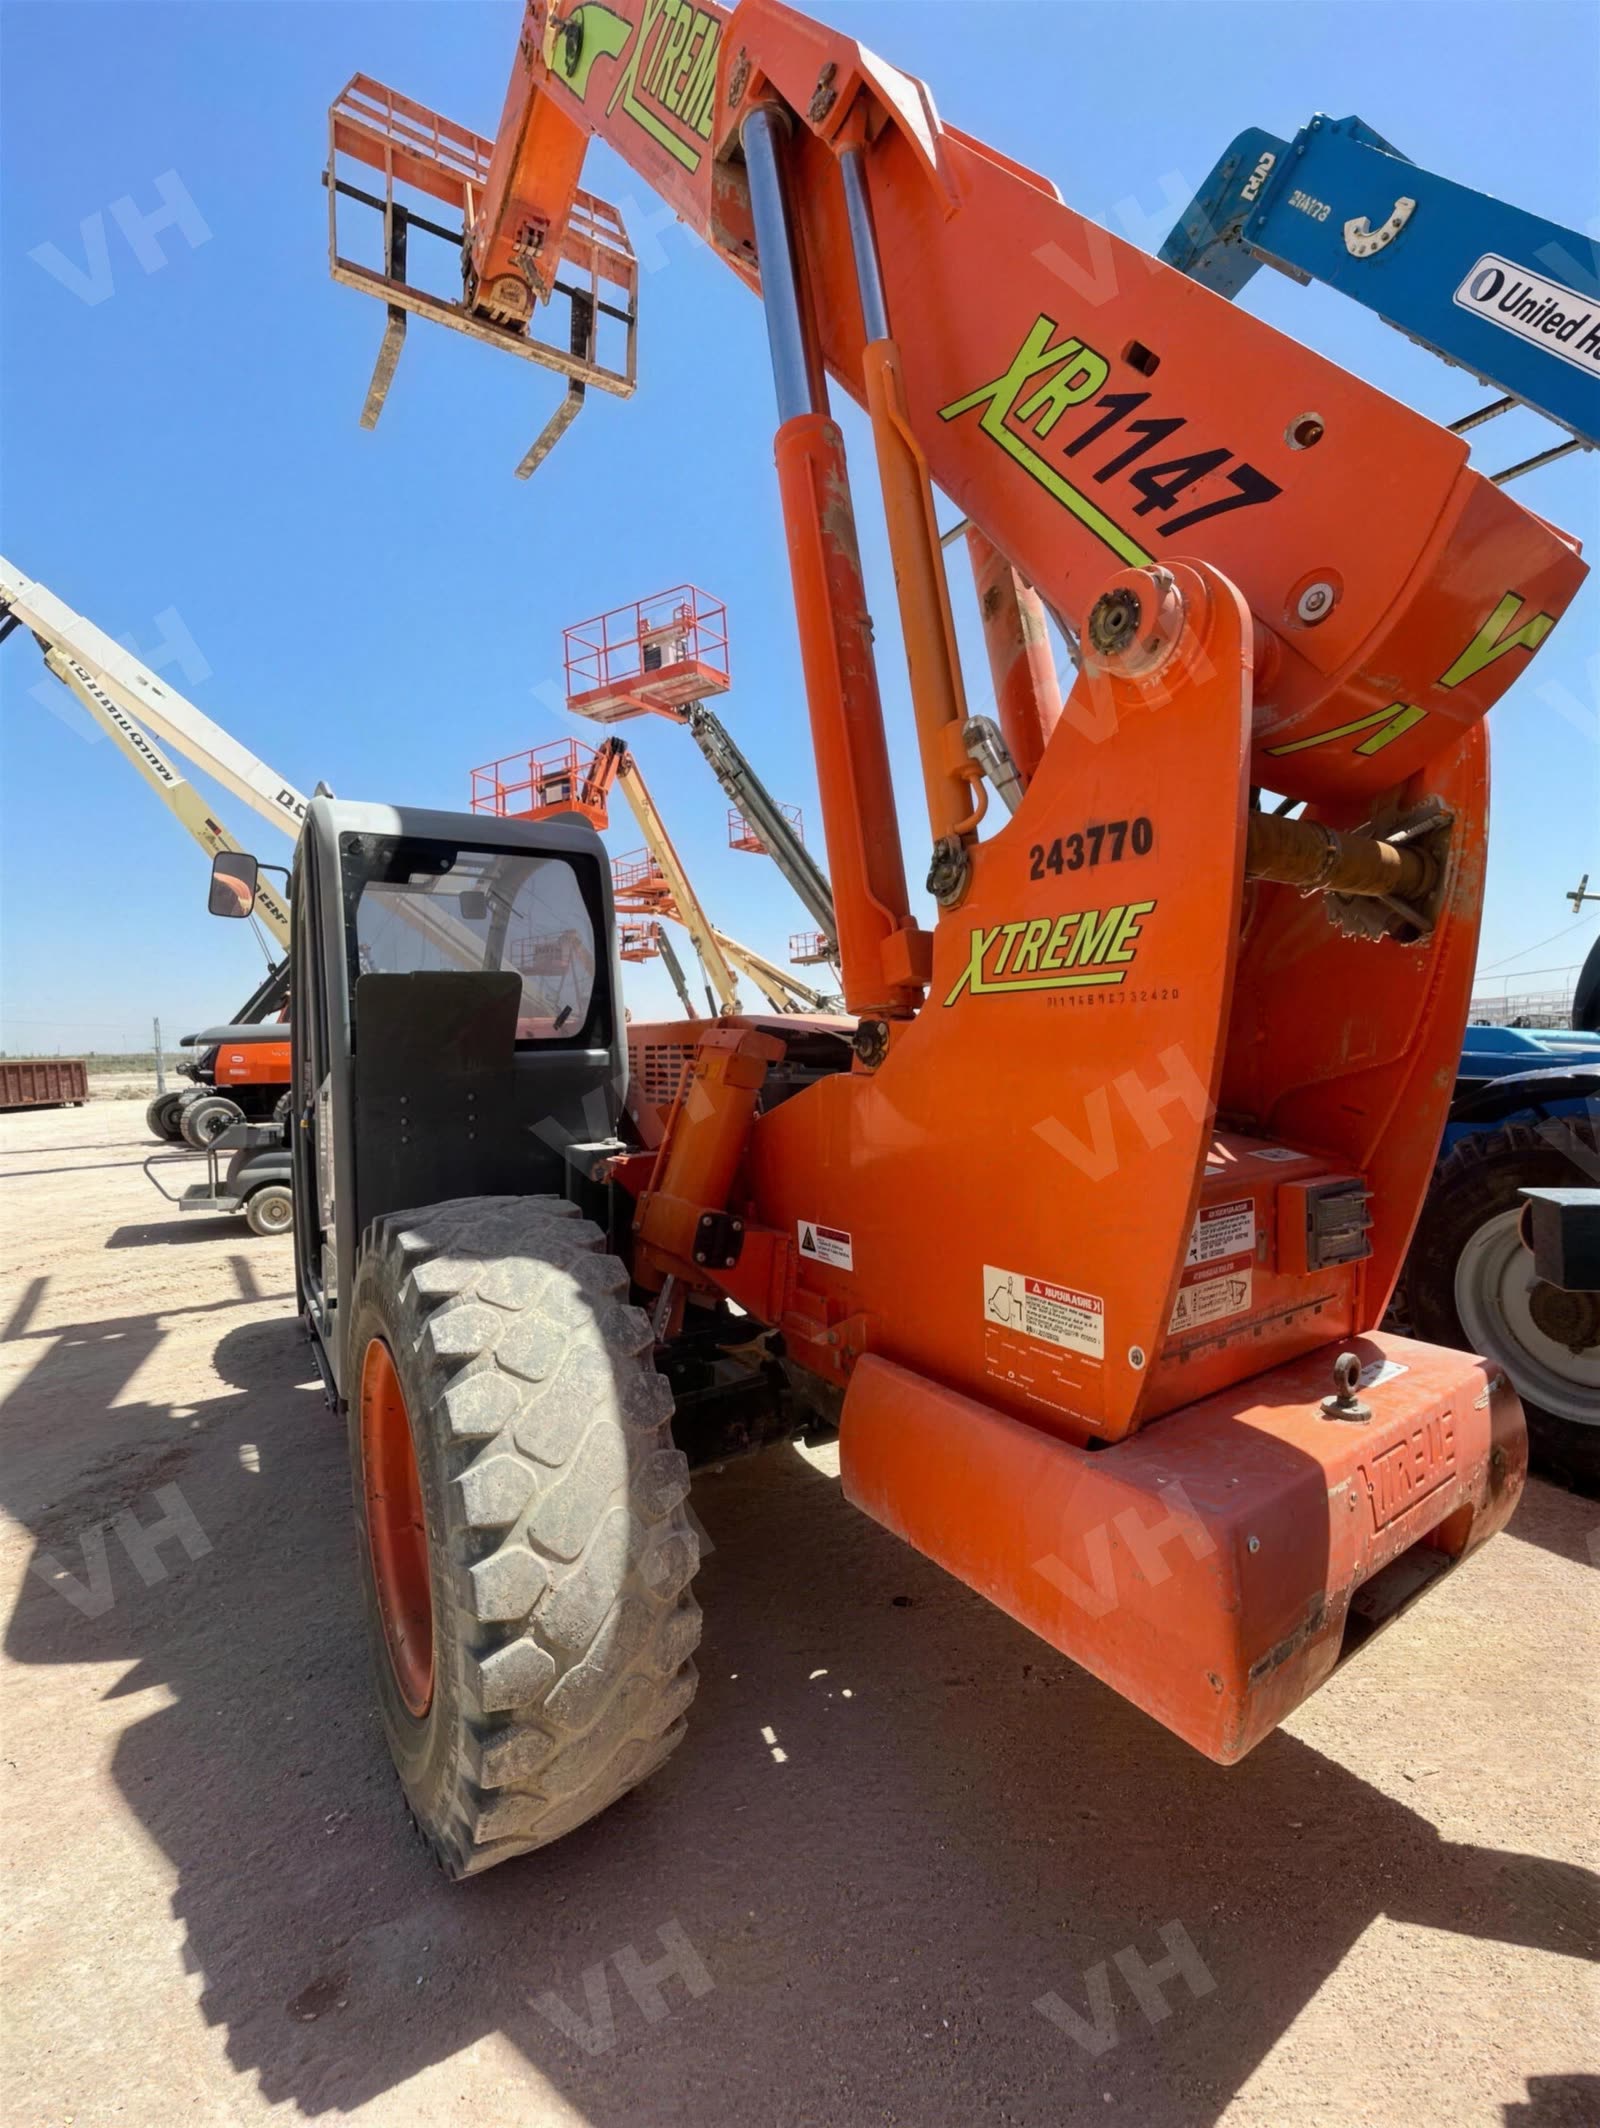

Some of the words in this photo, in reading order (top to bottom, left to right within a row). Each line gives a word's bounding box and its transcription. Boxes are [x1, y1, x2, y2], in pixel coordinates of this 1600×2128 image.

[1498, 281, 1592, 343] United
[936, 312, 1284, 568] XR1147
[1029, 816, 1154, 881] 243770
[943, 899, 1157, 1008] XTREME
